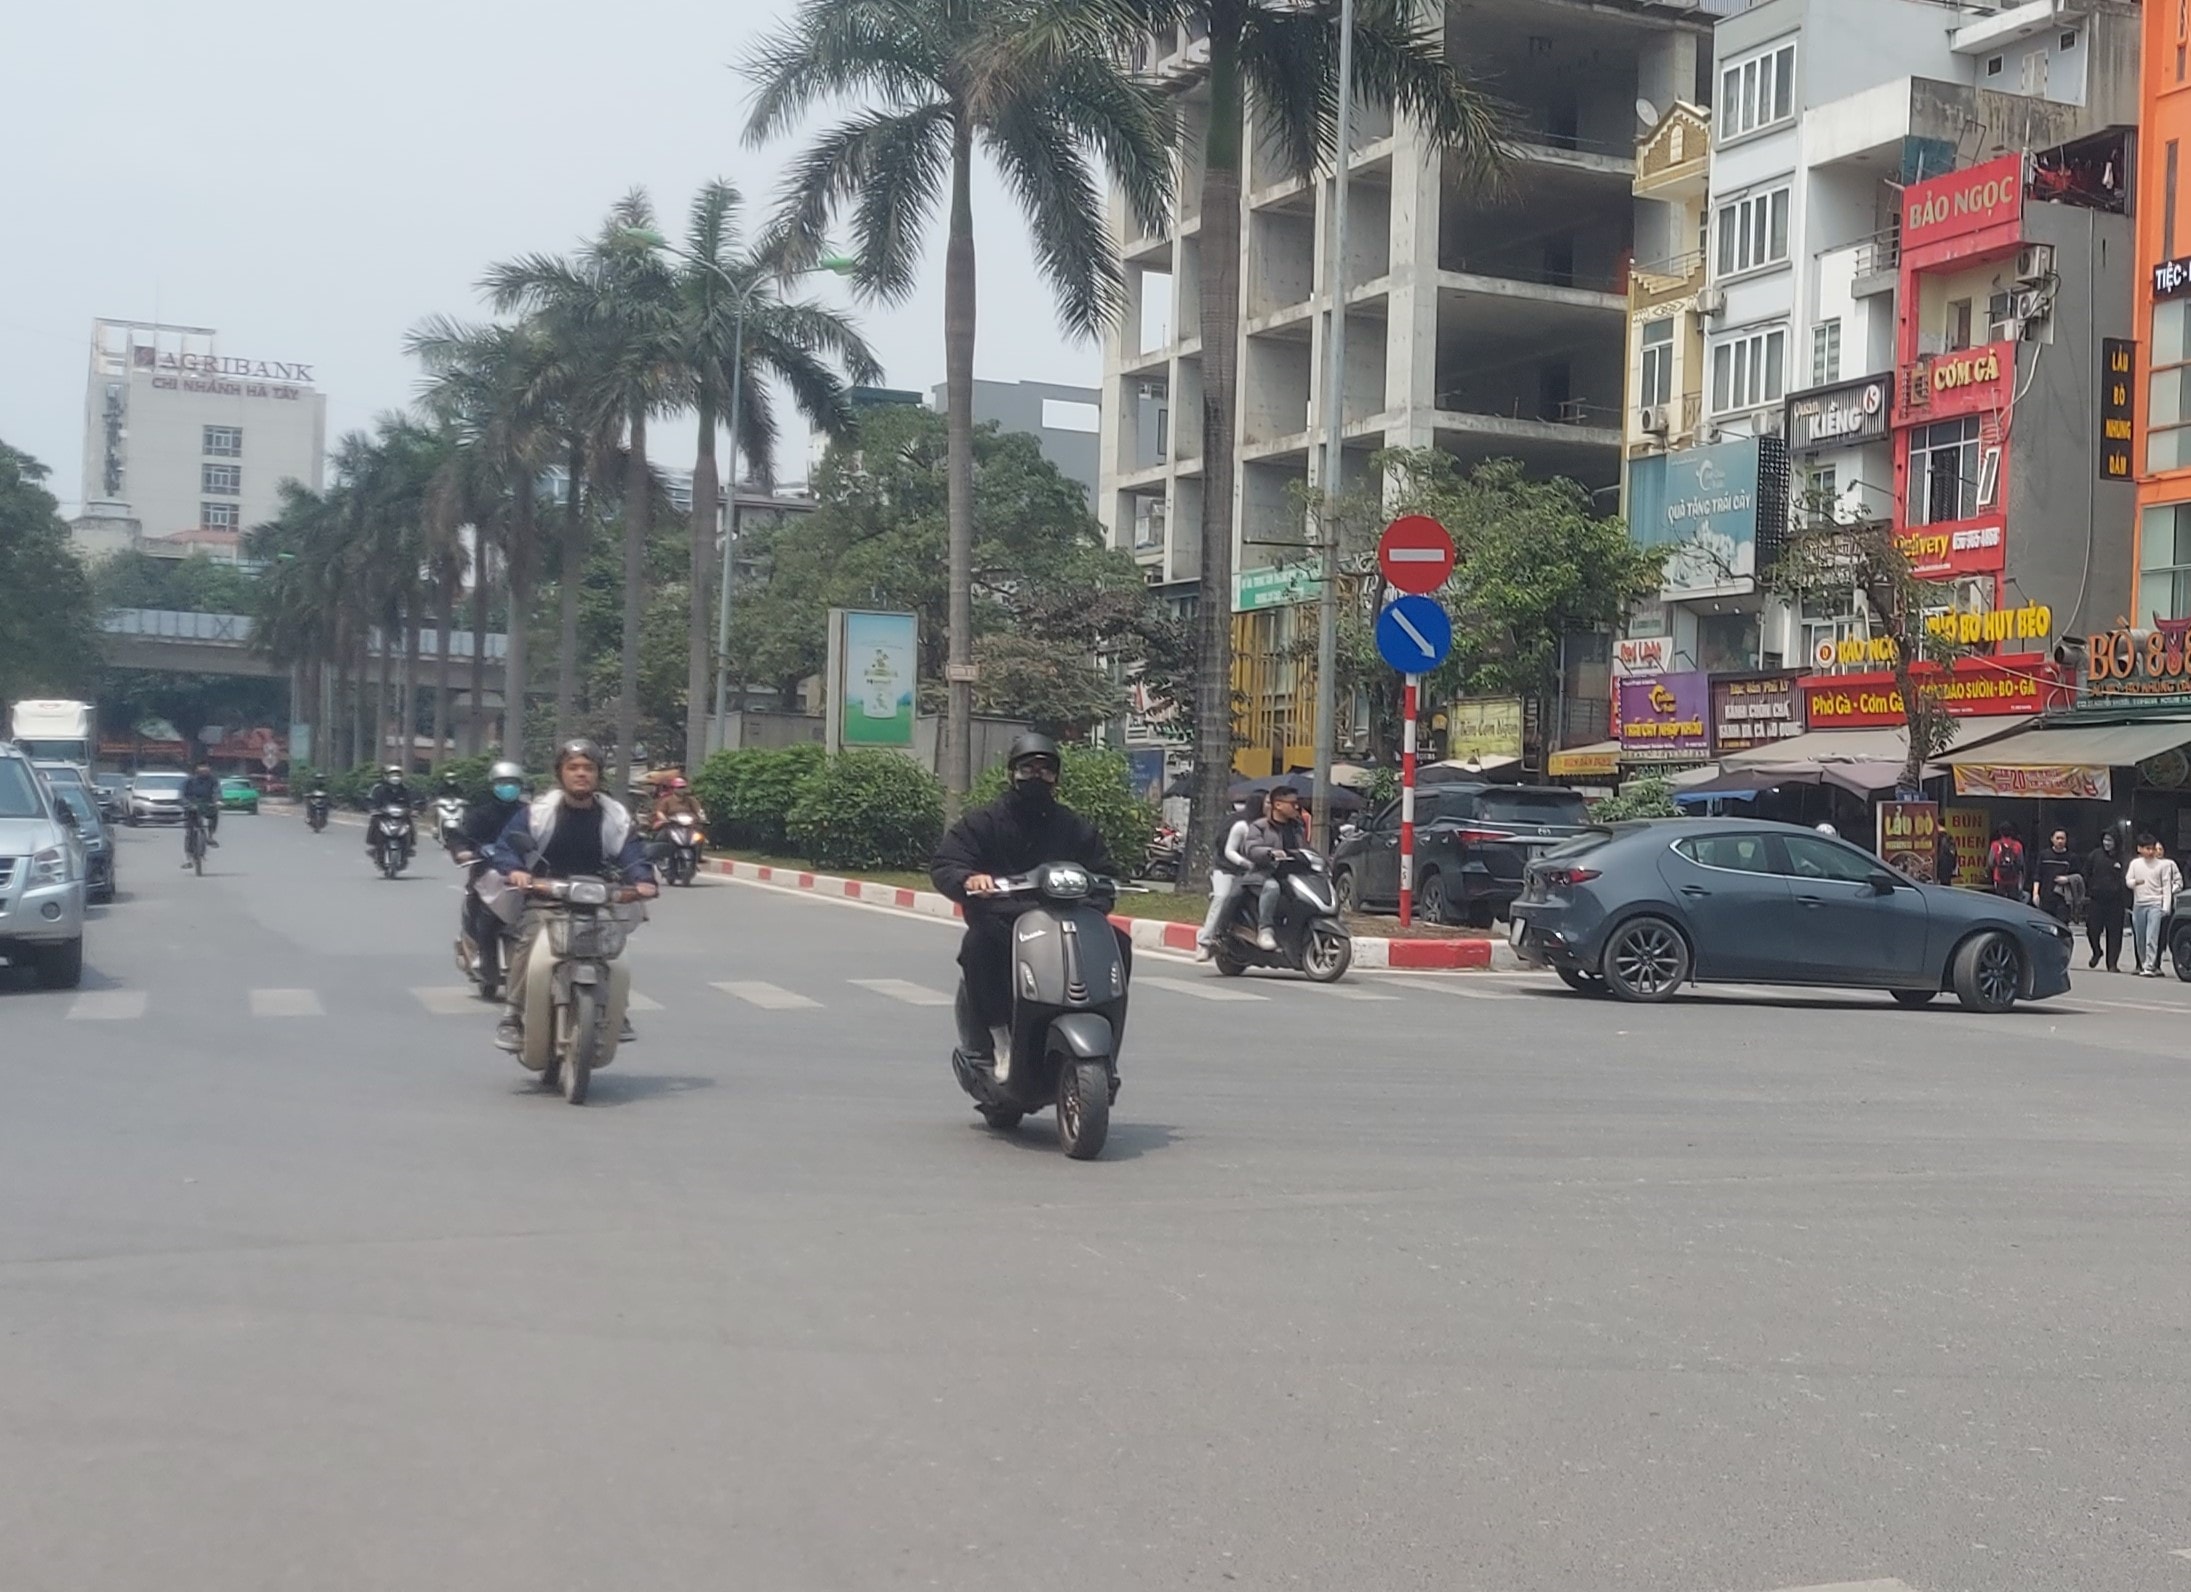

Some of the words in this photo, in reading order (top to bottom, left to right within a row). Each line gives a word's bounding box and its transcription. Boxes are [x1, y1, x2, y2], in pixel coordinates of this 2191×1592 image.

[1909, 190, 1950, 230] BẢO
[1953, 175, 2014, 217] NGỌC
[158, 352, 315, 381] AGRIBANK
[1934, 357, 1973, 391] CƠM
[1974, 348, 2000, 382] GÀ
[152, 377, 177, 390] CHI
[183, 379, 241, 396] NHÁNH
[1959, 603, 1982, 644] BÒ
[1983, 609, 2015, 642] HUY
[2017, 599, 2051, 639] BÉO
[2087, 615, 2135, 681] BÒ
[1812, 690, 1834, 716] Phở
[1835, 692, 1852, 715] Gà
[1860, 692, 1888, 714] Cơm
[2011, 769, 2027, 790] 20
